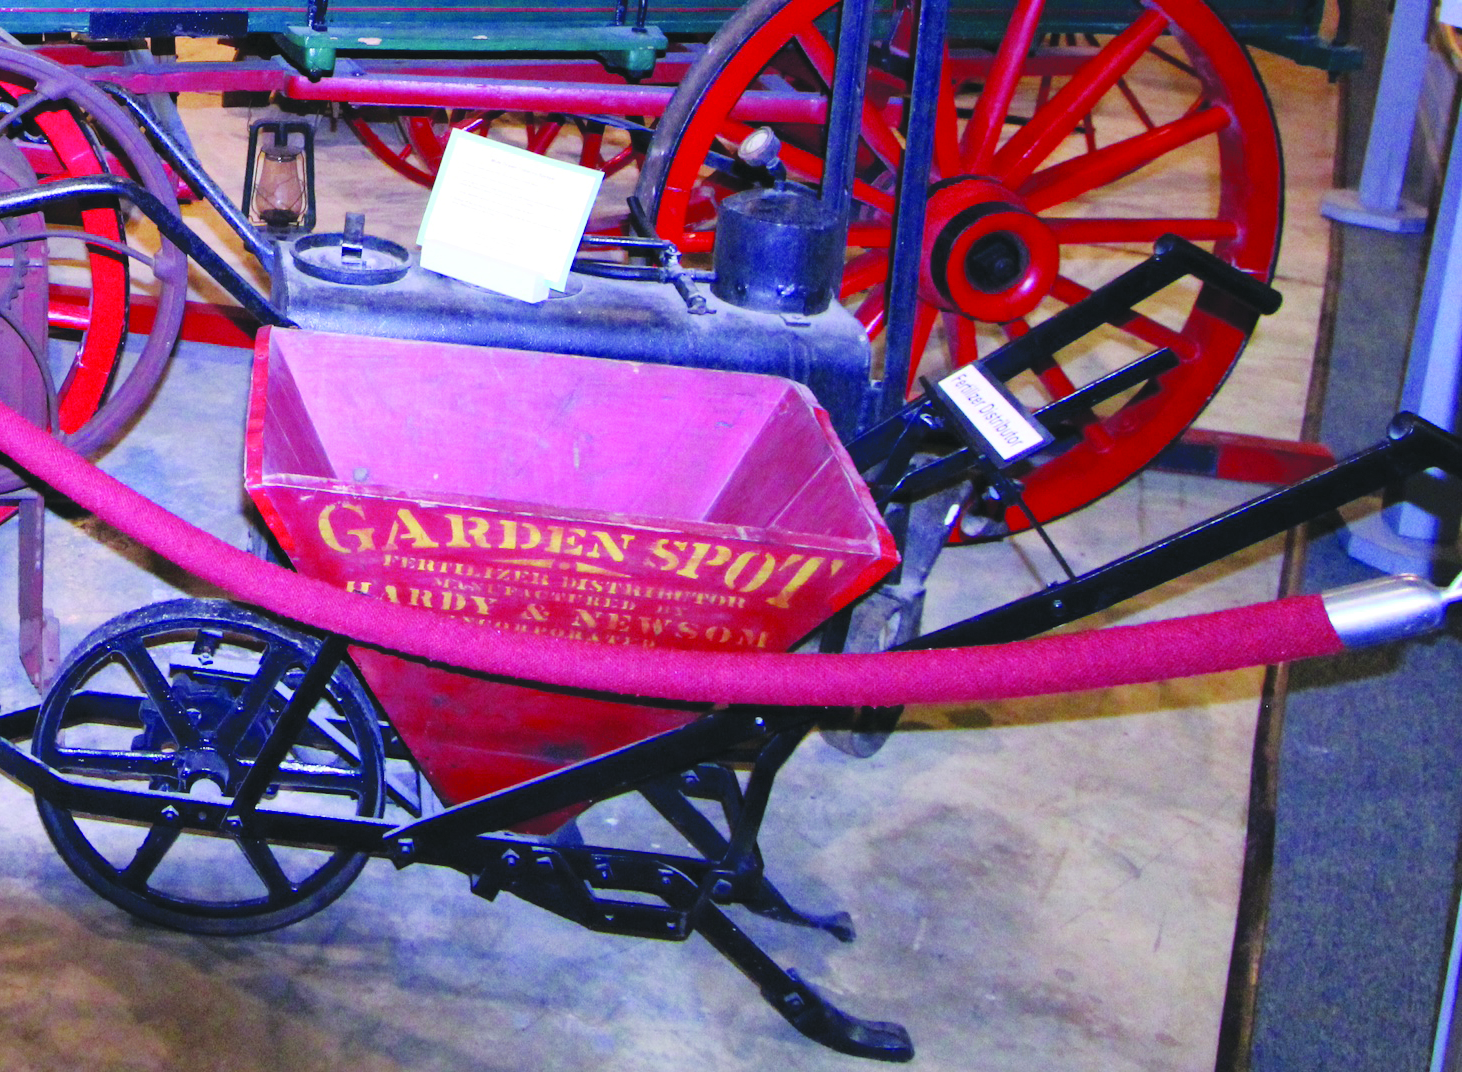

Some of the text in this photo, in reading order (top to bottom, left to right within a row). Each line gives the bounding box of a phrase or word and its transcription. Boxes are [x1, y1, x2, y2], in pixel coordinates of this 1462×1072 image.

[950, 372, 1024, 447] Fertilizer Distributor
[317, 502, 844, 609] GARDEN SPOT
[383, 554, 746, 610] FERTILIZER DISTRIBUTOR
[346, 580, 769, 648] HARDY & NEWSOM
